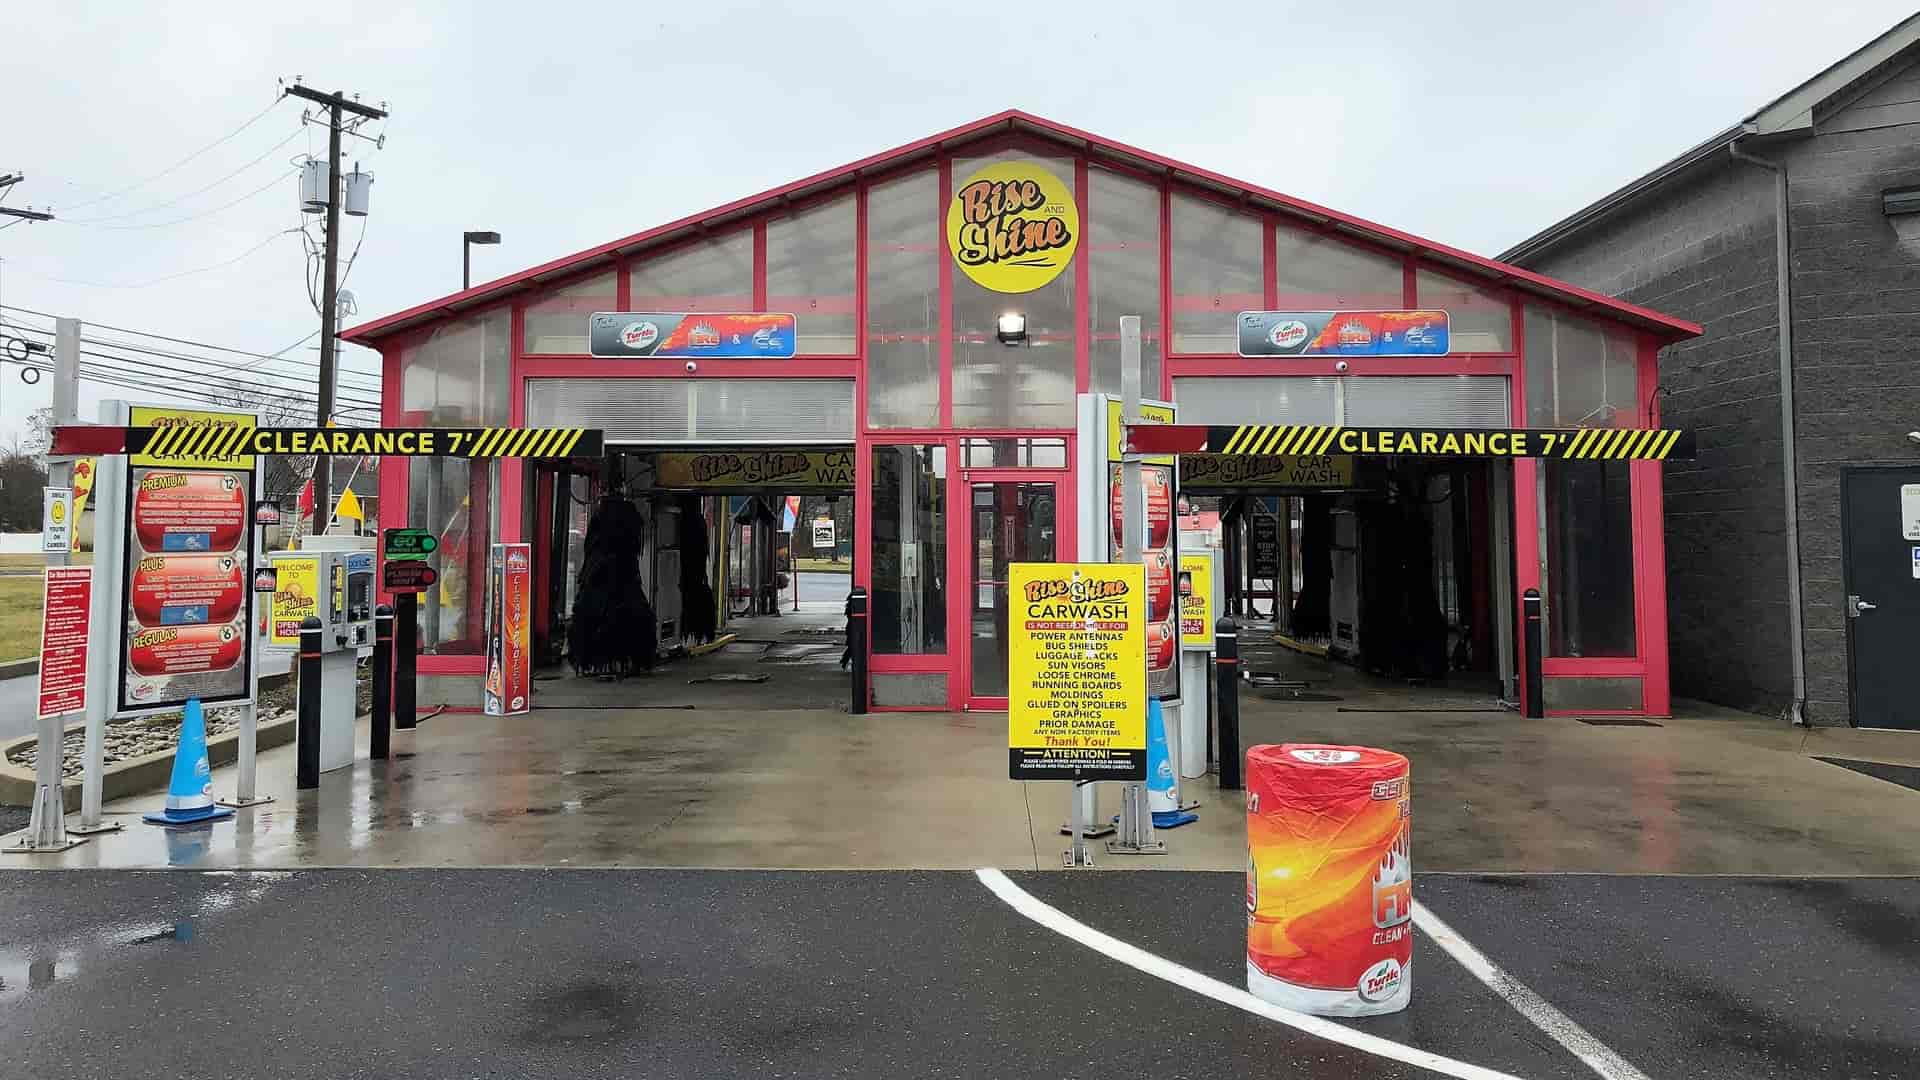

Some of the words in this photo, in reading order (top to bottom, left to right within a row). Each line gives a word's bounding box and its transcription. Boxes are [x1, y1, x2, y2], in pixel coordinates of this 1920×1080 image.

[959, 180, 1046, 223] Rise
[959, 216, 1071, 265] Shine
[254, 432, 435, 453] CLEARANCE
[448, 433, 472, 453] 7'
[1339, 431, 1527, 455] CLEARANCE
[1540, 434, 1566, 455] 7'
[691, 454, 741, 482] Rise
[743, 452, 810, 483] Shine
[824, 453, 855, 467] CA
[1296, 456, 1332, 468] CAR
[142, 474, 188, 491] PREMIUM
[1290, 471, 1340, 483] WASH
[140, 558, 165, 571] PLUS
[1024, 580, 1069, 602] Rise
[1069, 578, 1129, 603] Shine
[274, 609, 314, 617] CARWASH
[1028, 605, 1128, 619] CARWASH
[132, 628, 177, 649] REGULAR
[1069, 633, 1123, 641] ANTENNAS
[1046, 642, 1066, 650] BUG
[1069, 642, 1108, 650] SHIELDS
[1035, 652, 1083, 660] LUGGAGE
[1086, 652, 1118, 660] ACKS
[1038, 671, 1070, 679] LOOSE
[1073, 671, 1116, 679] CHROME
[1032, 681, 1079, 689] RUNNING
[1082, 681, 1122, 689] BOARDS
[1051, 691, 1104, 699] MOLDINGS
[1027, 700, 1060, 708] GLUED
[1081, 701, 1127, 709] SPOILERS
[1053, 710, 1102, 718] GRAPHICS
[1039, 720, 1068, 728] PRIOR
[1071, 721, 1116, 729] DAMAGE
[1044, 736, 1079, 747] Thank
[1084, 737, 1111, 747] You!
[1043, 750, 1110, 759] ATTENTION!
[1372, 928, 1403, 945] CLEAN
[1368, 969, 1399, 990] Turtle
